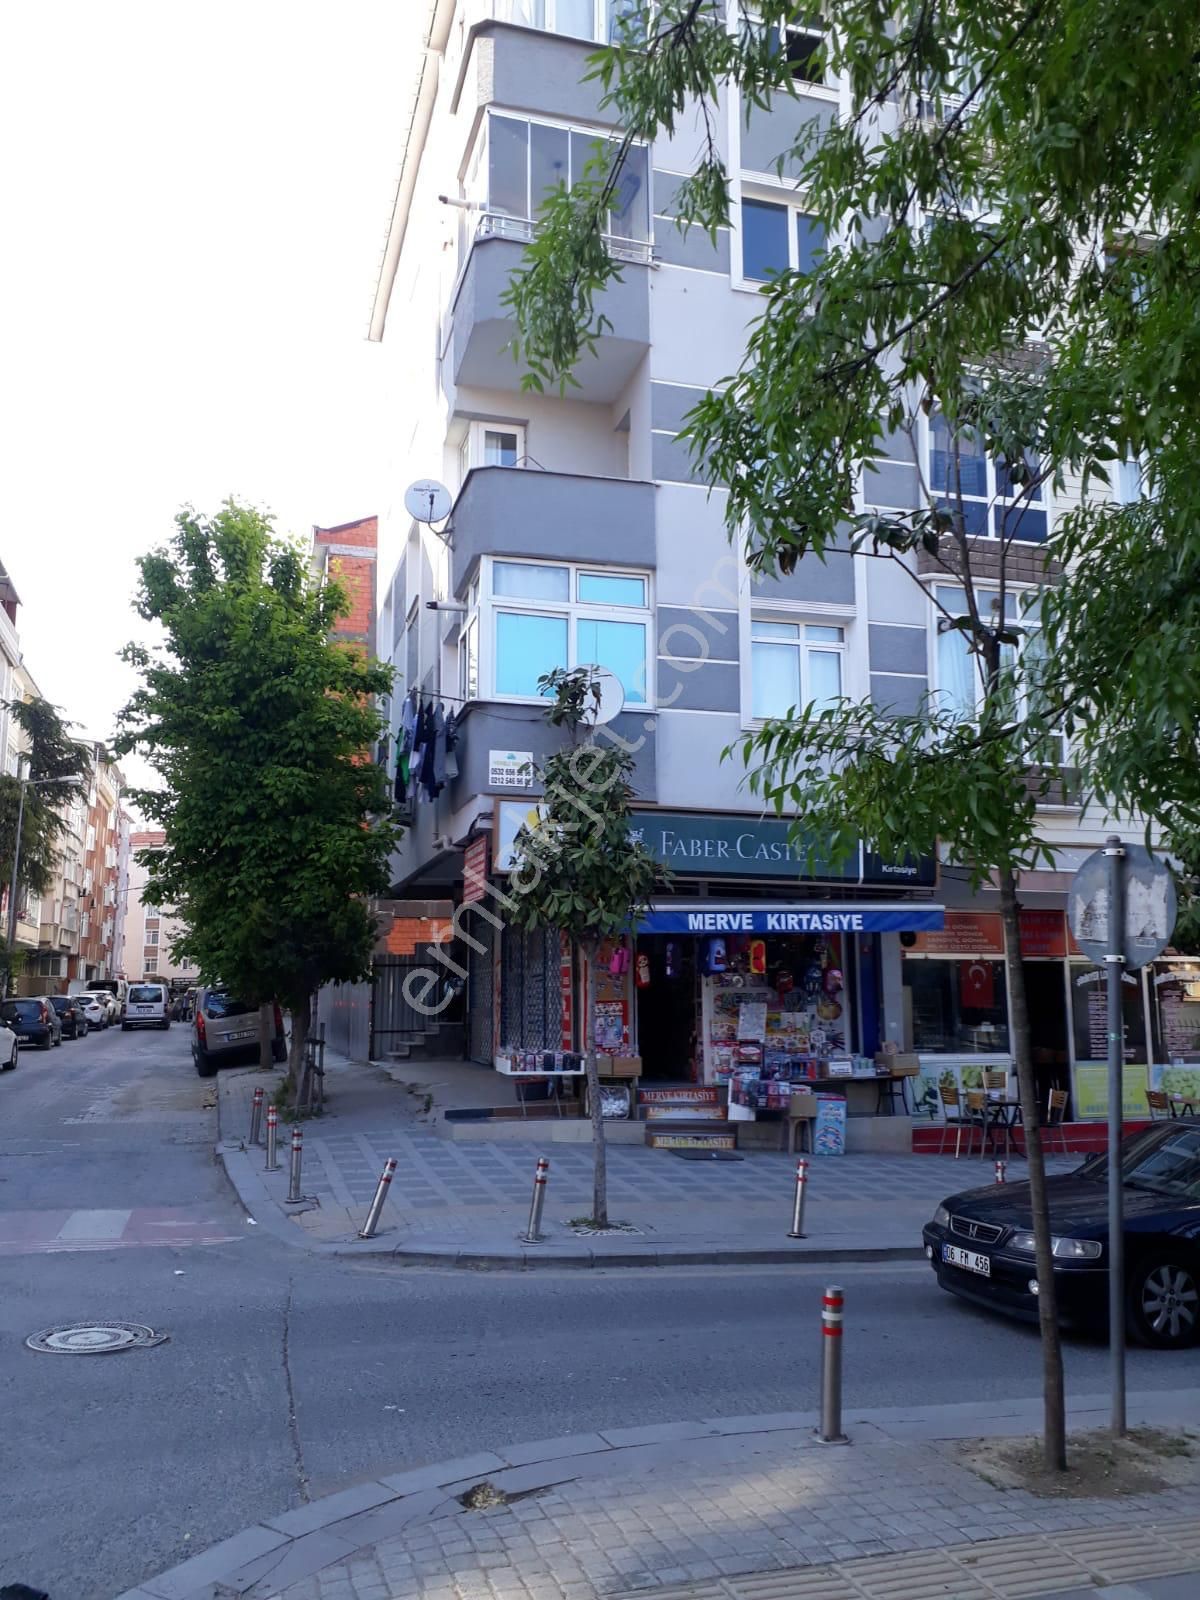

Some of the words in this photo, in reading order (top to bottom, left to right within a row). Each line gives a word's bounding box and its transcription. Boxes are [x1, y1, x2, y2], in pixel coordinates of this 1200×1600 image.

[660, 829, 829, 863] FABER-CASTE
[688, 913, 754, 931] MERVE
[946, 1246, 955, 1260] 06
[960, 1250, 969, 1265] FM
